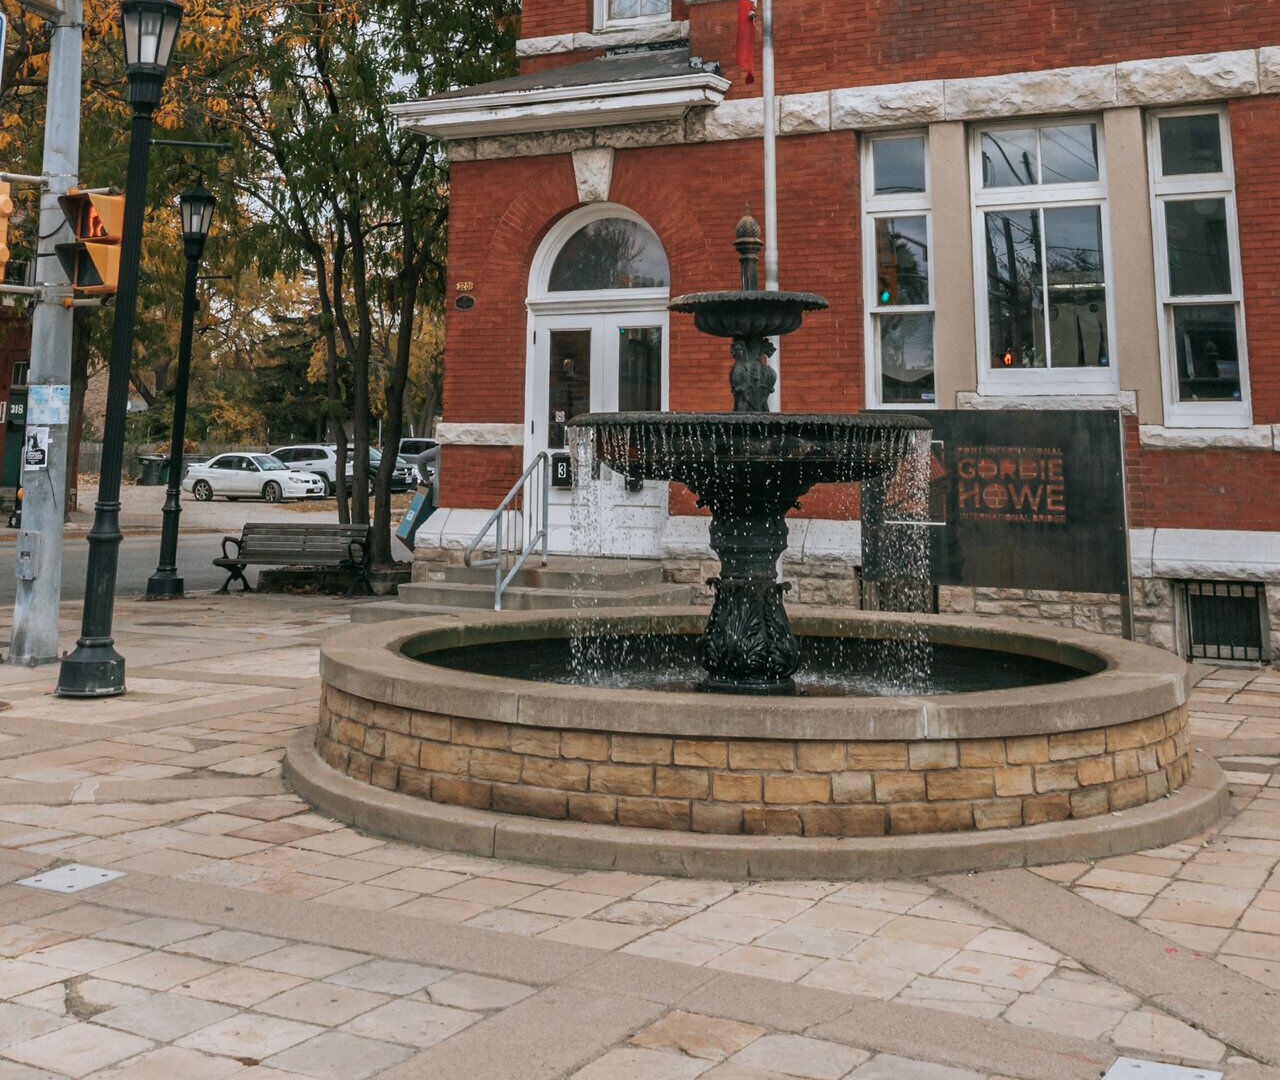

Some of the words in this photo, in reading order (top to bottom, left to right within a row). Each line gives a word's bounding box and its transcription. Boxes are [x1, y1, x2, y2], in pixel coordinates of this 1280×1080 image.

[10, 404, 24, 414] 318
[559, 463, 566, 477] 3
[958, 458, 1065, 481] GORDIE
[959, 482, 1066, 512] HOWE
